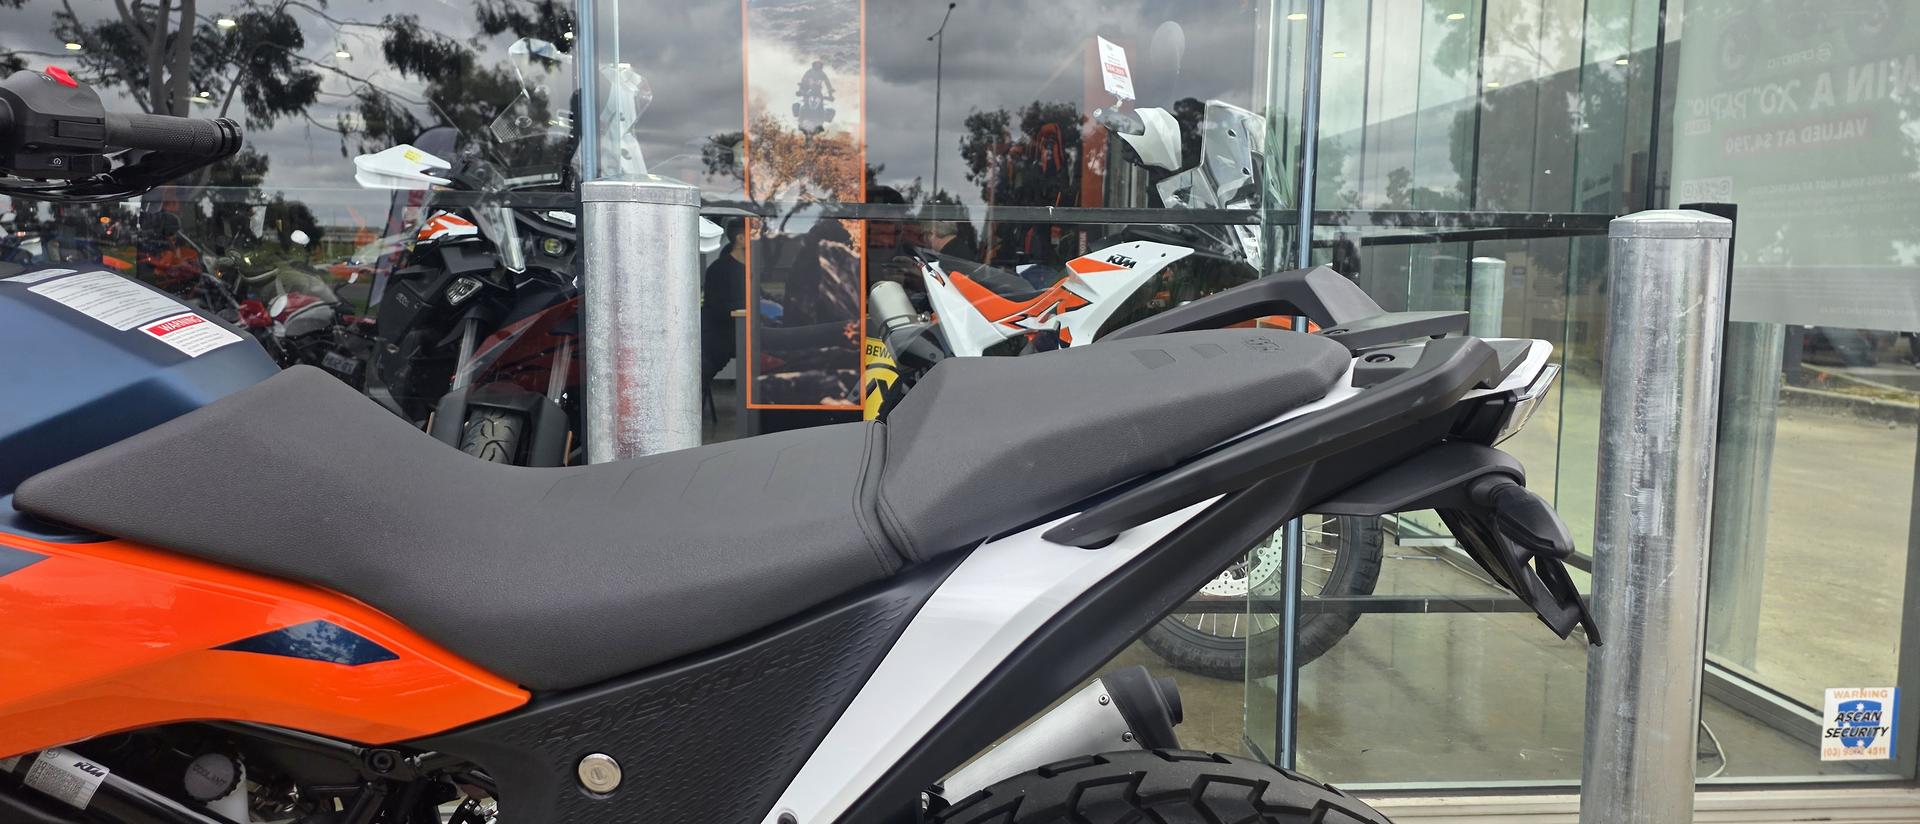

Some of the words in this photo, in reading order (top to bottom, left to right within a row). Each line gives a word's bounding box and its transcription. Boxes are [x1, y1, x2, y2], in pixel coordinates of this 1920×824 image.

[1106, 254, 1137, 269] KTM
[157, 315, 203, 332] WARNING
[1834, 690, 1888, 699] WARNING
[1834, 711, 1882, 722] ASCAN
[1825, 726, 1889, 738] SECURITY
[73, 761, 106, 778] KTM
